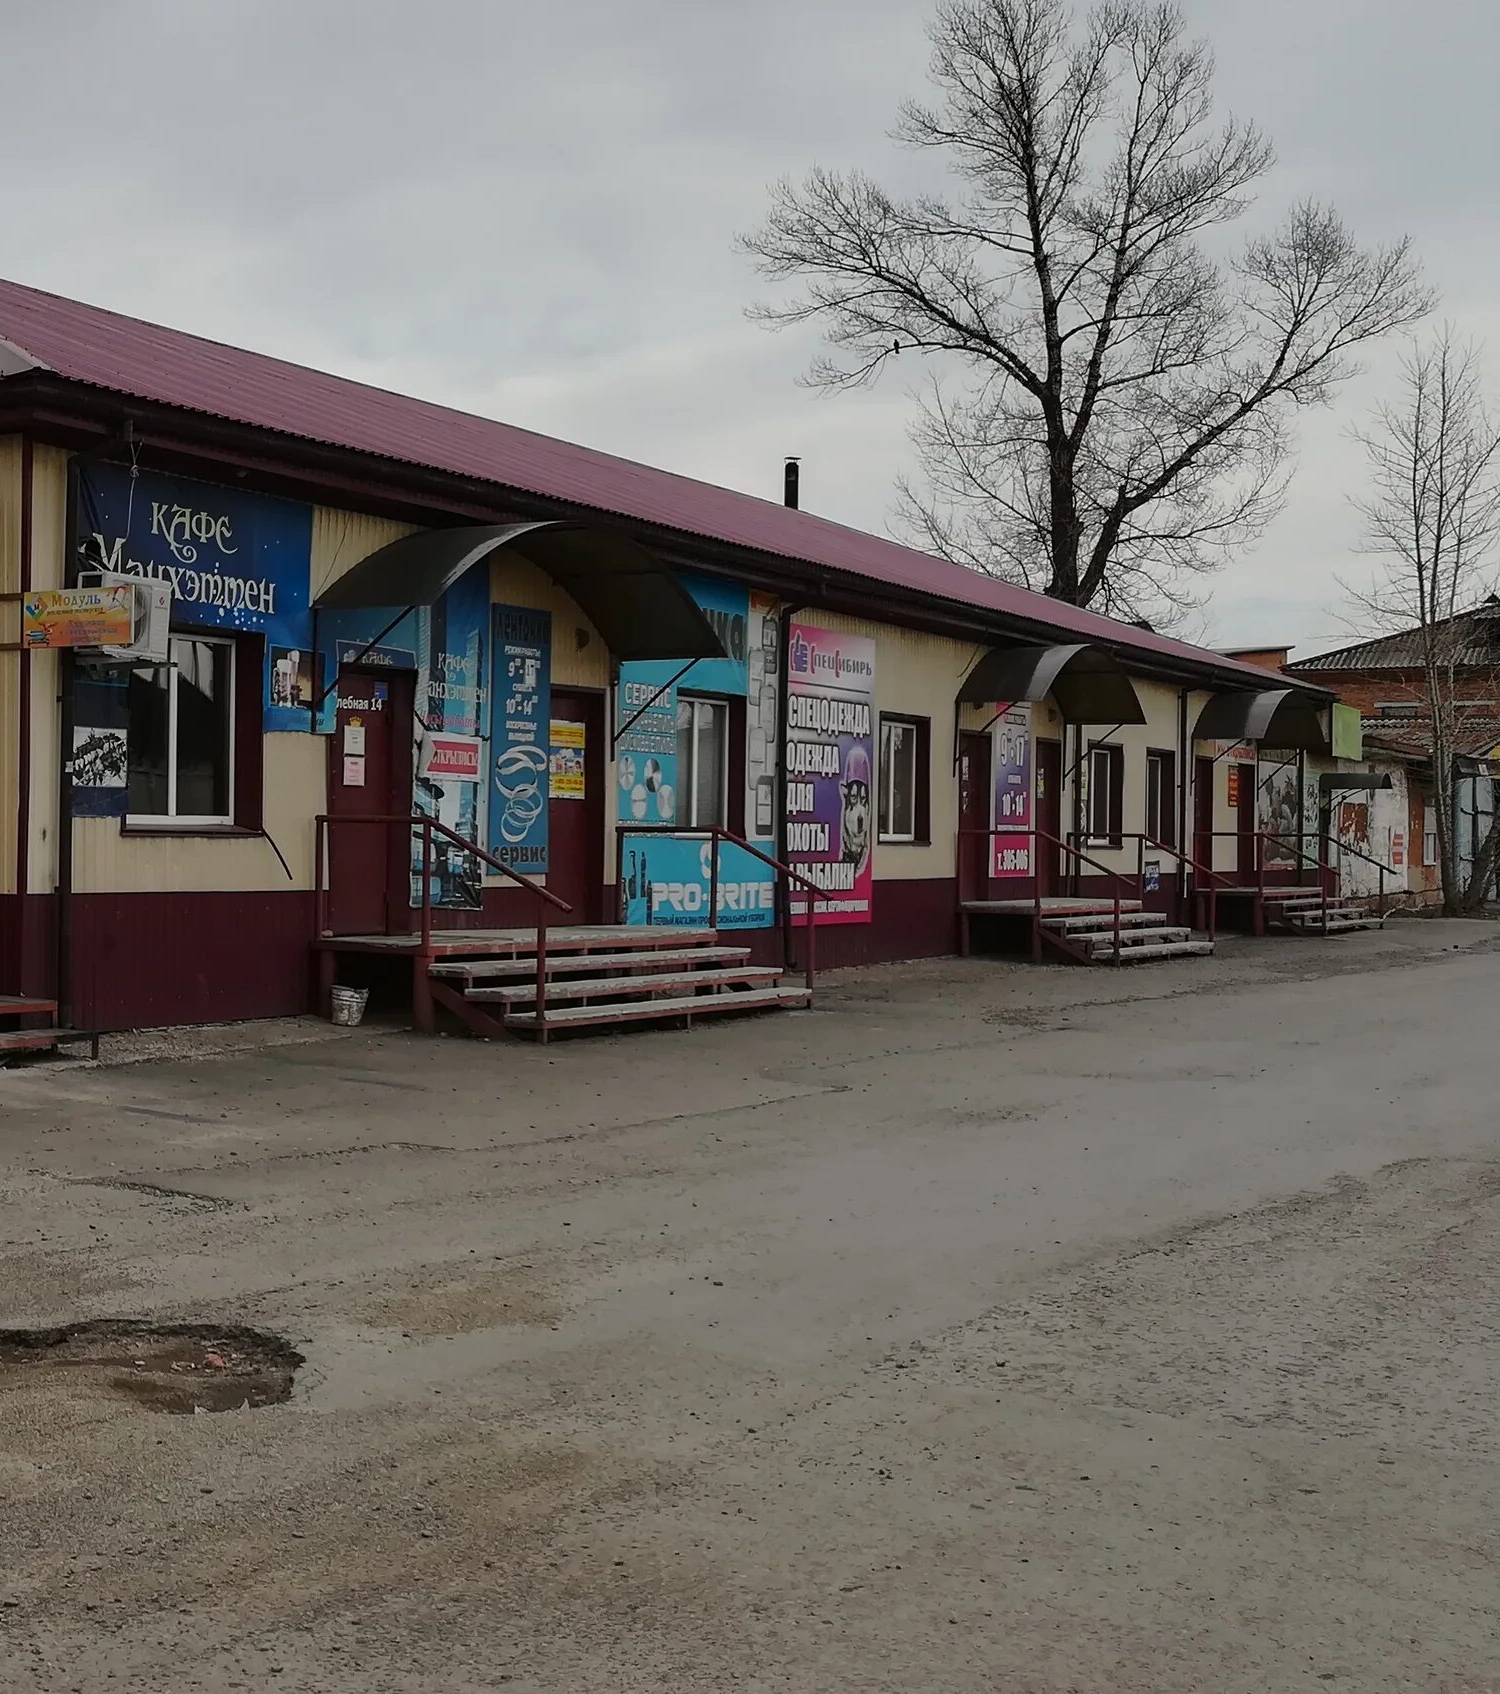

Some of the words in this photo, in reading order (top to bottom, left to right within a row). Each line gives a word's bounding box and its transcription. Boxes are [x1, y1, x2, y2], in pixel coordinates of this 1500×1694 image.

[150, 501, 238, 563] КАФЕ
[51, 594, 101, 608] Модуль
[337, 695, 369, 711] лебная
[370, 700, 383, 711] 14
[625, 677, 672, 708] СЕРВИС
[788, 695, 870, 738] СПЕЦОДЕЖДА
[787, 742, 840, 776] ОДЕЖДА
[786, 782, 814, 815] ДЛЯ
[786, 822, 830, 852] ОХОТЫ
[492, 846, 547, 867] сервис
[795, 862, 855, 891] РЫБАЛКИ
[651, 881, 773, 911] PRO-BRITE
